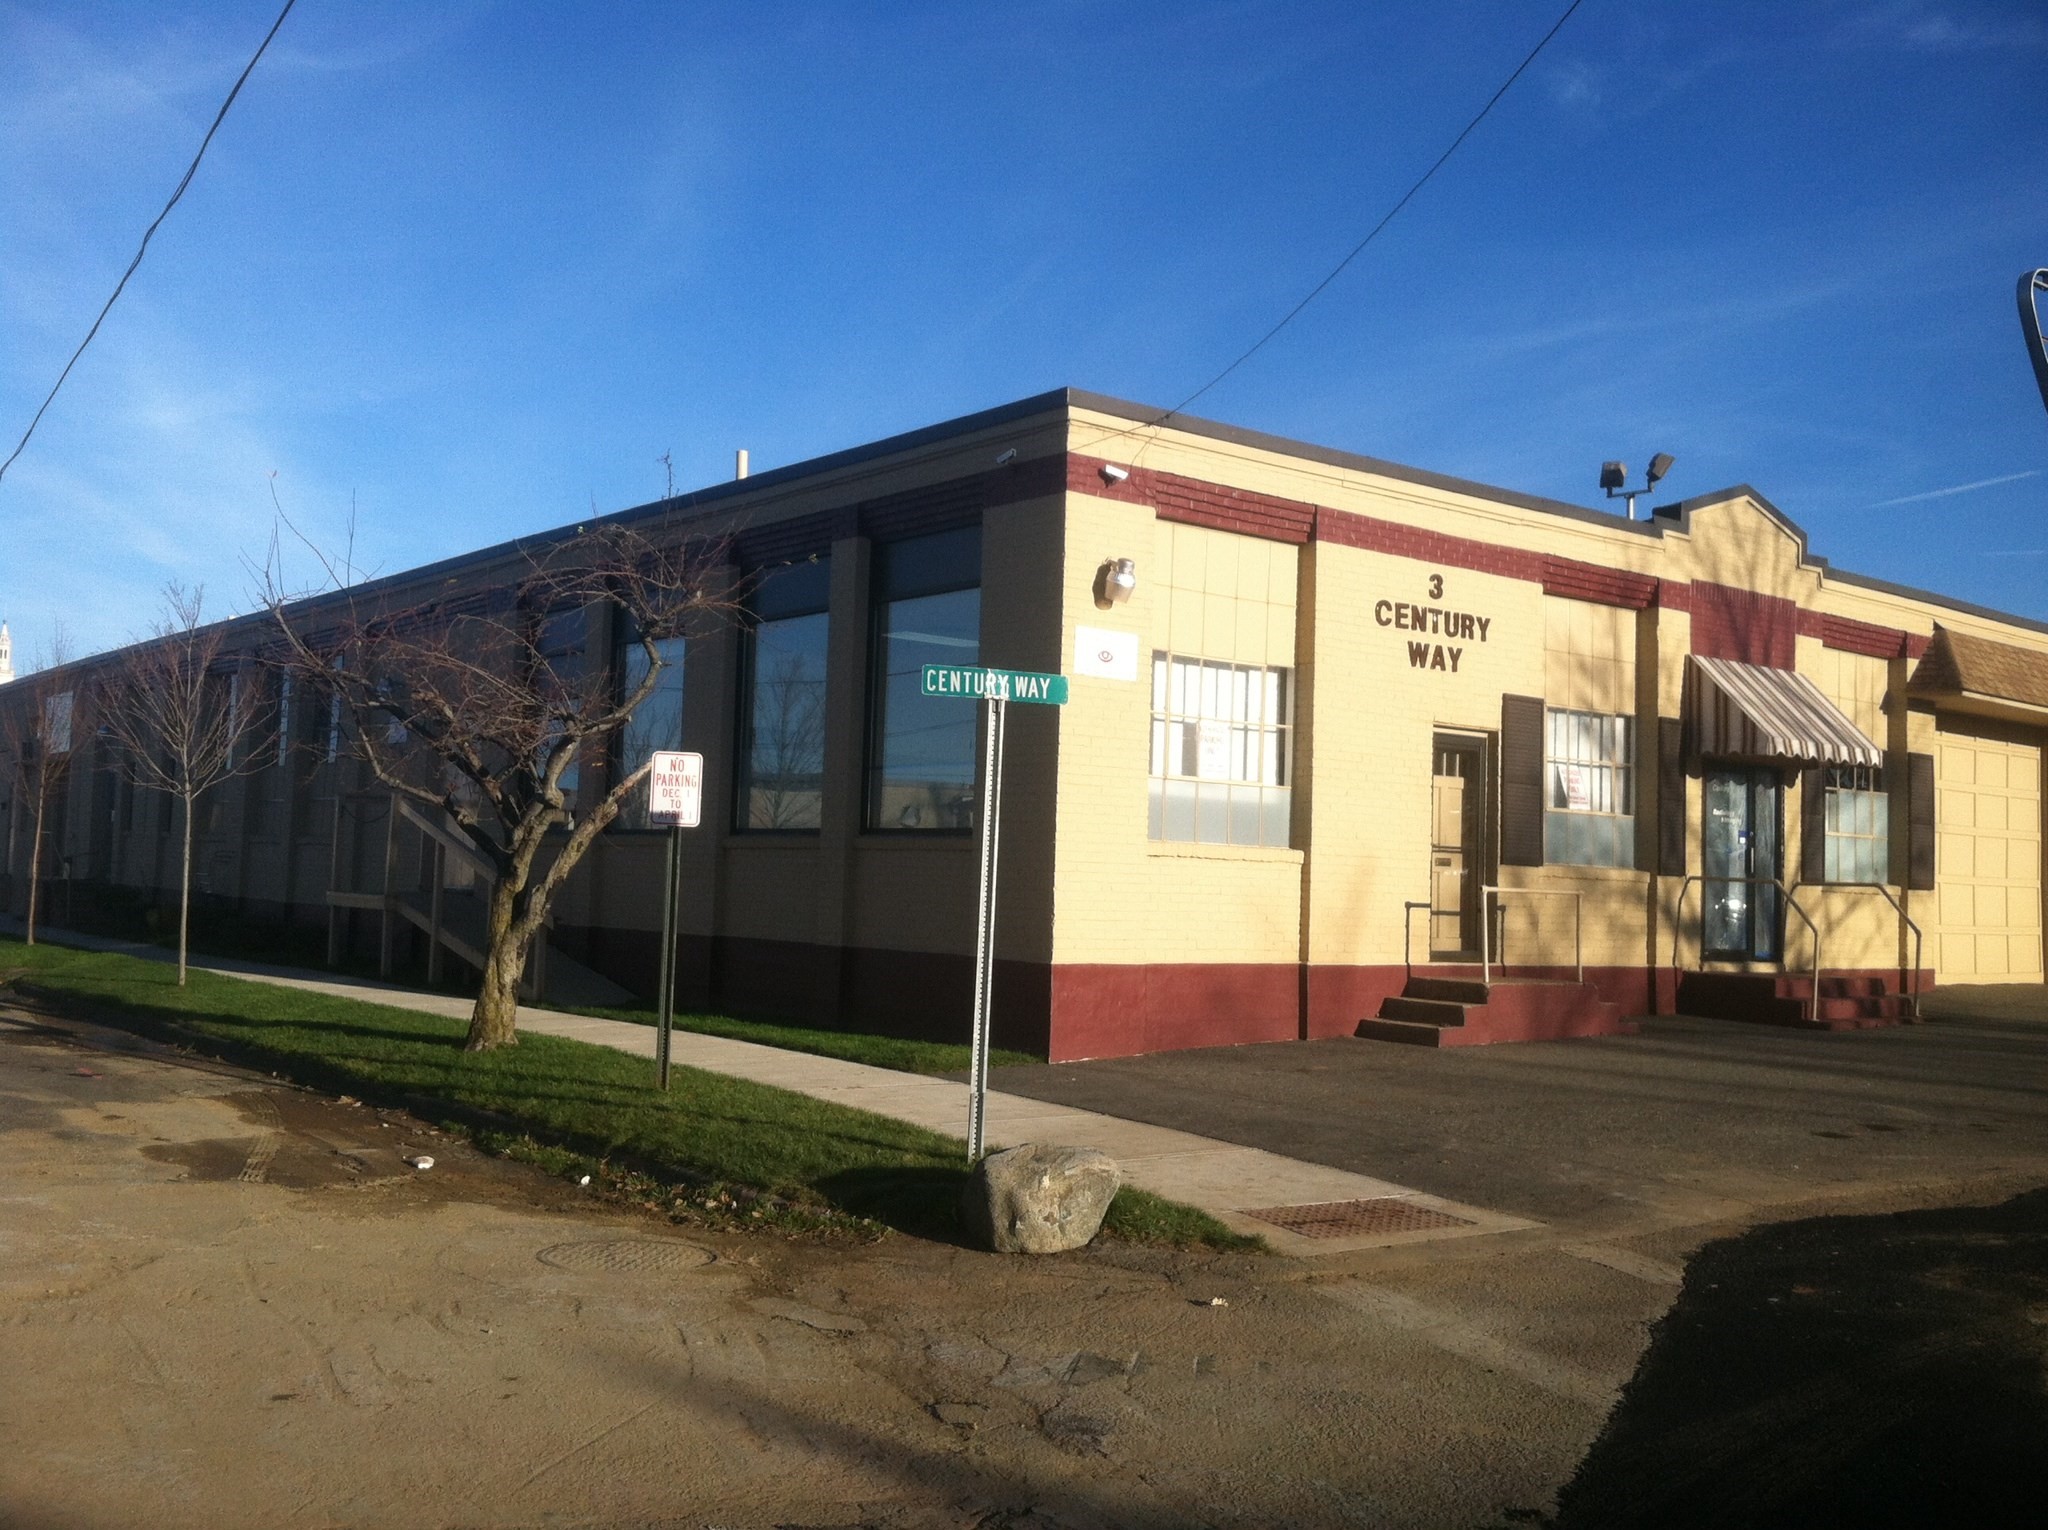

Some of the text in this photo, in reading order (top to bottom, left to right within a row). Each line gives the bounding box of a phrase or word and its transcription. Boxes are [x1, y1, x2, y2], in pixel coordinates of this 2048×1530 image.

[1428, 573, 1444, 600] 3
[1374, 599, 1491, 642] CENTURY
[1407, 640, 1463, 673] WAY
[926, 668, 1051, 700] CENTURY WAY
[669, 758, 685, 773] NO
[655, 773, 697, 788] PARKING
[670, 799, 682, 809] TO
[657, 810, 685, 820] APRIL
